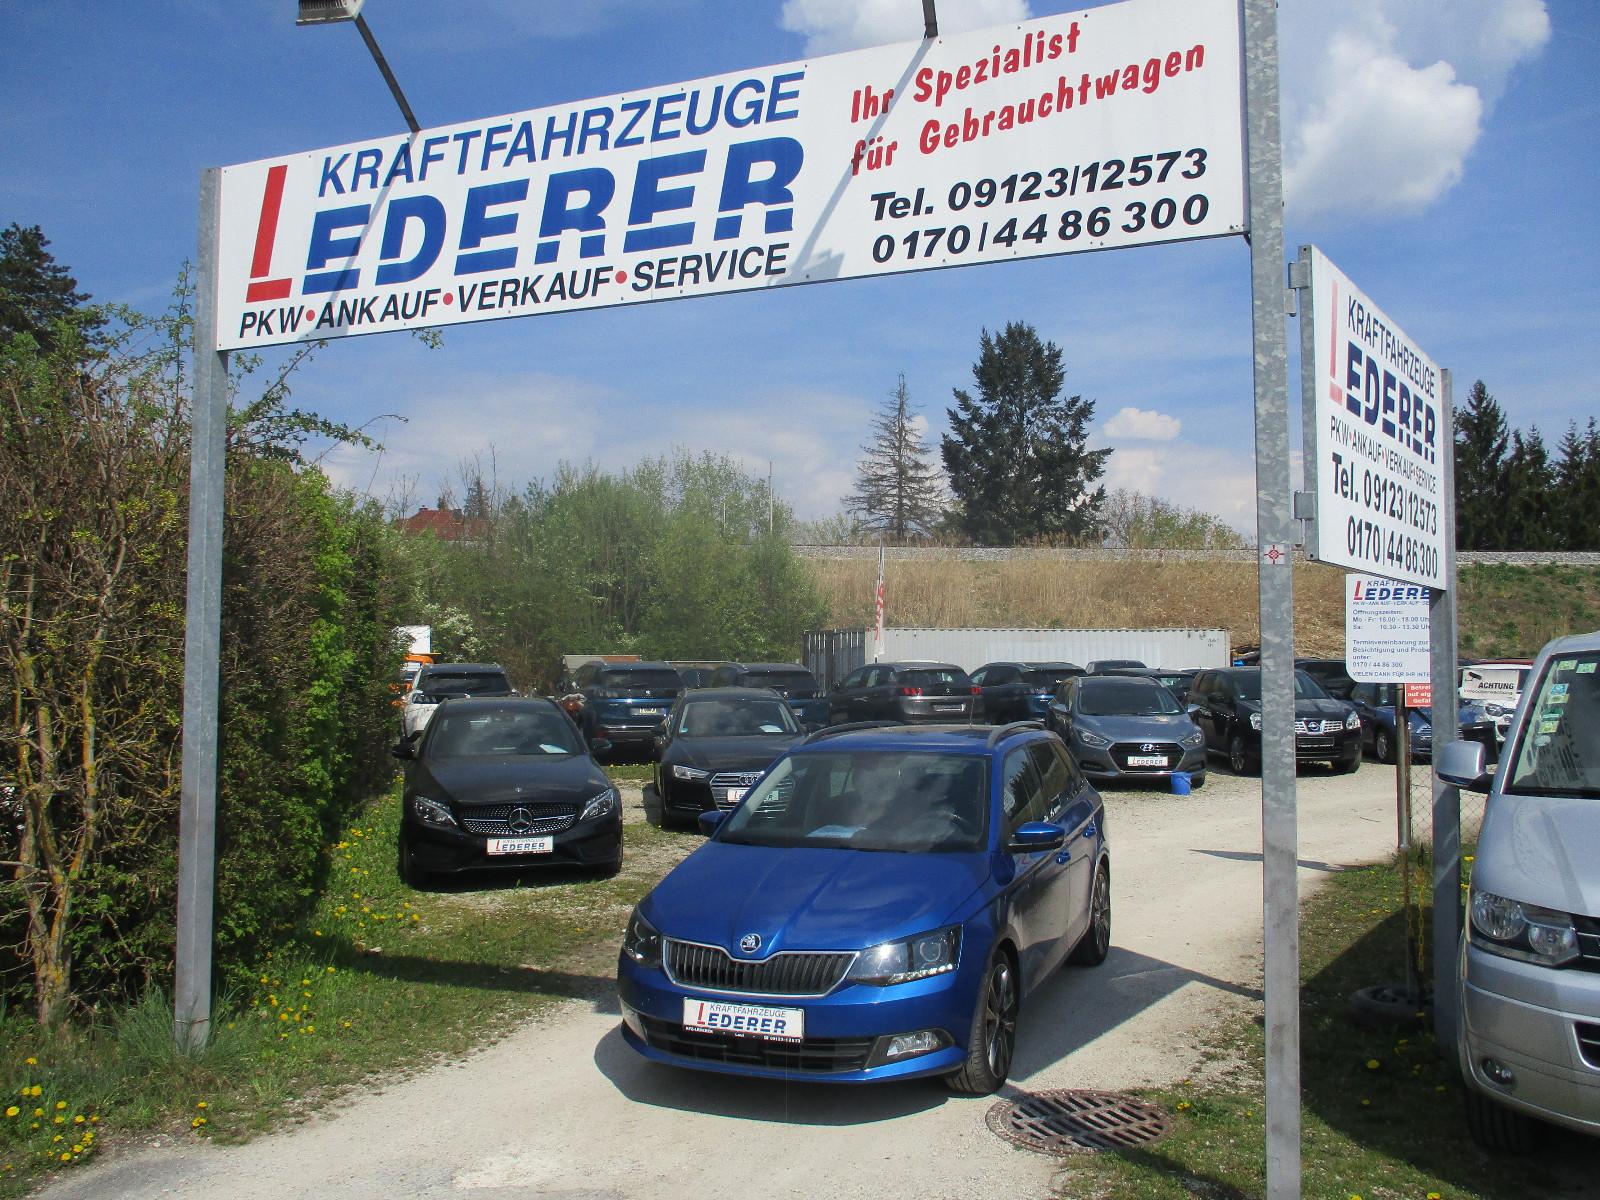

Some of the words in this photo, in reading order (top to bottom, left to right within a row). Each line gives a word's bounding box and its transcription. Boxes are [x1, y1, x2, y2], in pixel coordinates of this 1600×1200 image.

[850, 85, 895, 123] Ihr
[913, 21, 1081, 107] Spezialist
[850, 136, 897, 176] für
[919, 43, 1205, 154] Gebrauchtwagen
[318, 71, 805, 197] KRAFTFAHRZEUGE
[246, 137, 804, 303] LEDERER
[870, 187, 933, 221] Tel.
[947, 147, 1208, 212] 09123/12573
[631, 242, 790, 292] SERVICE
[1329, 279, 1436, 465] LEDERER
[1348, 294, 1435, 399] KRAFTFAHRZEUGE
[1332, 452, 1358, 503] Tel.
[1363, 468, 1437, 536] 09123/12573
[1353, 580, 1430, 600] LEDERE
[495, 840, 545, 852] LEDERER
[697, 1002, 787, 1034] LEDERER
[710, 1003, 786, 1018] KRAFTFAHRZEUGE
